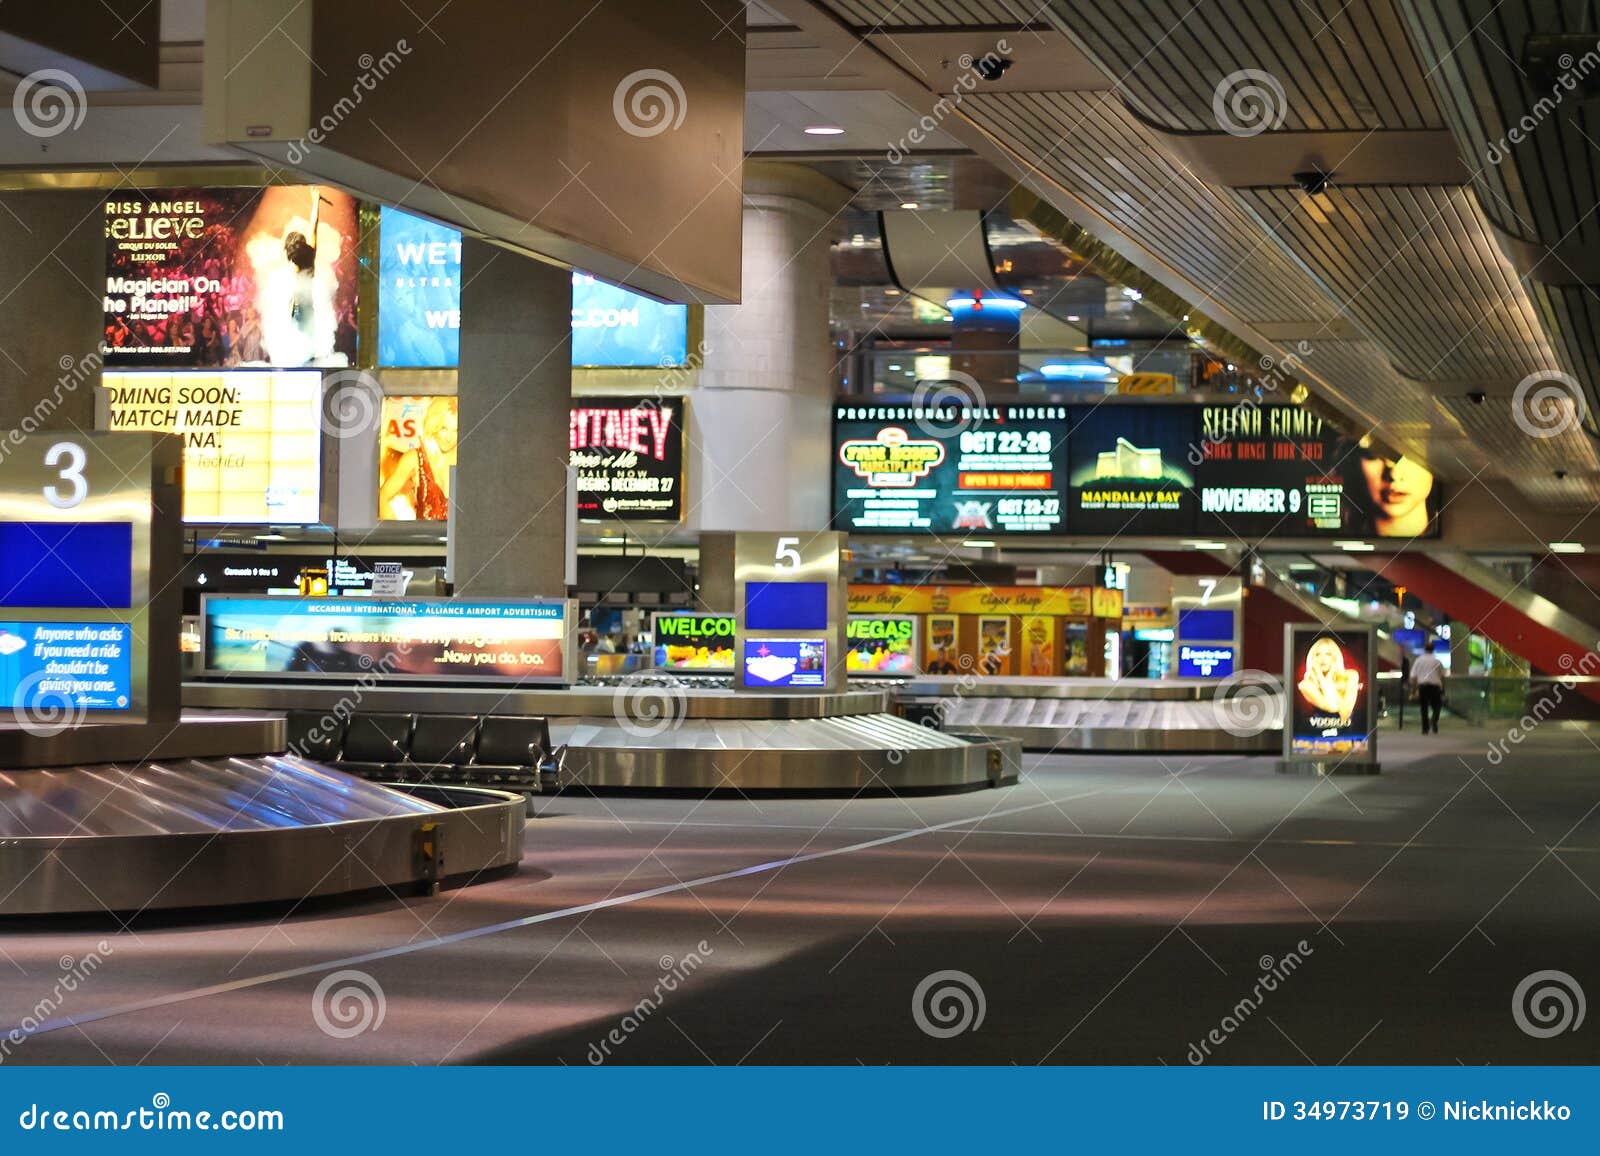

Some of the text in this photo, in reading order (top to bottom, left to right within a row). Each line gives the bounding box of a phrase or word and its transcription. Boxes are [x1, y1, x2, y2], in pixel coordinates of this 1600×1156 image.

[106, 201, 205, 214] RISS ANGEL
[131, 253, 165, 261] LUXOR
[107, 276, 220, 297] Magician On
[103, 296, 127, 312] he
[178, 387, 242, 404] SOON:
[110, 410, 243, 426] MATCH MADE
[837, 408, 1067, 420] PROFESSIONAL BULL RIDERS
[1203, 407, 1262, 437] SELENA
[960, 431, 997, 453] OCT
[43, 441, 88, 509] 3
[617, 470, 648, 478] NOW
[611, 477, 660, 492] DECEMBER
[660, 477, 675, 492] 27
[1081, 491, 1181, 503] MANDALAY BAY
[1201, 487, 1301, 513] NOVEMBER 9
[774, 537, 802, 575] 5
[374, 565, 400, 573] NOTICE
[1198, 579, 1217, 606] 7
[307, 605, 557, 617] MCCARRAN INTERNATIONAL ALLIANCE AIRPORT ADVERTISING
[34, 626, 123, 643] Anyone who asks
[659, 617, 736, 636] WELCO
[34, 642, 121, 661] if you need a ride
[474, 654, 496, 666] you
[499, 650, 518, 665] do,
[520, 651, 544, 665] too.
[45, 660, 109, 675] shouldn't be
[38, 677, 117, 695] giving you one.
